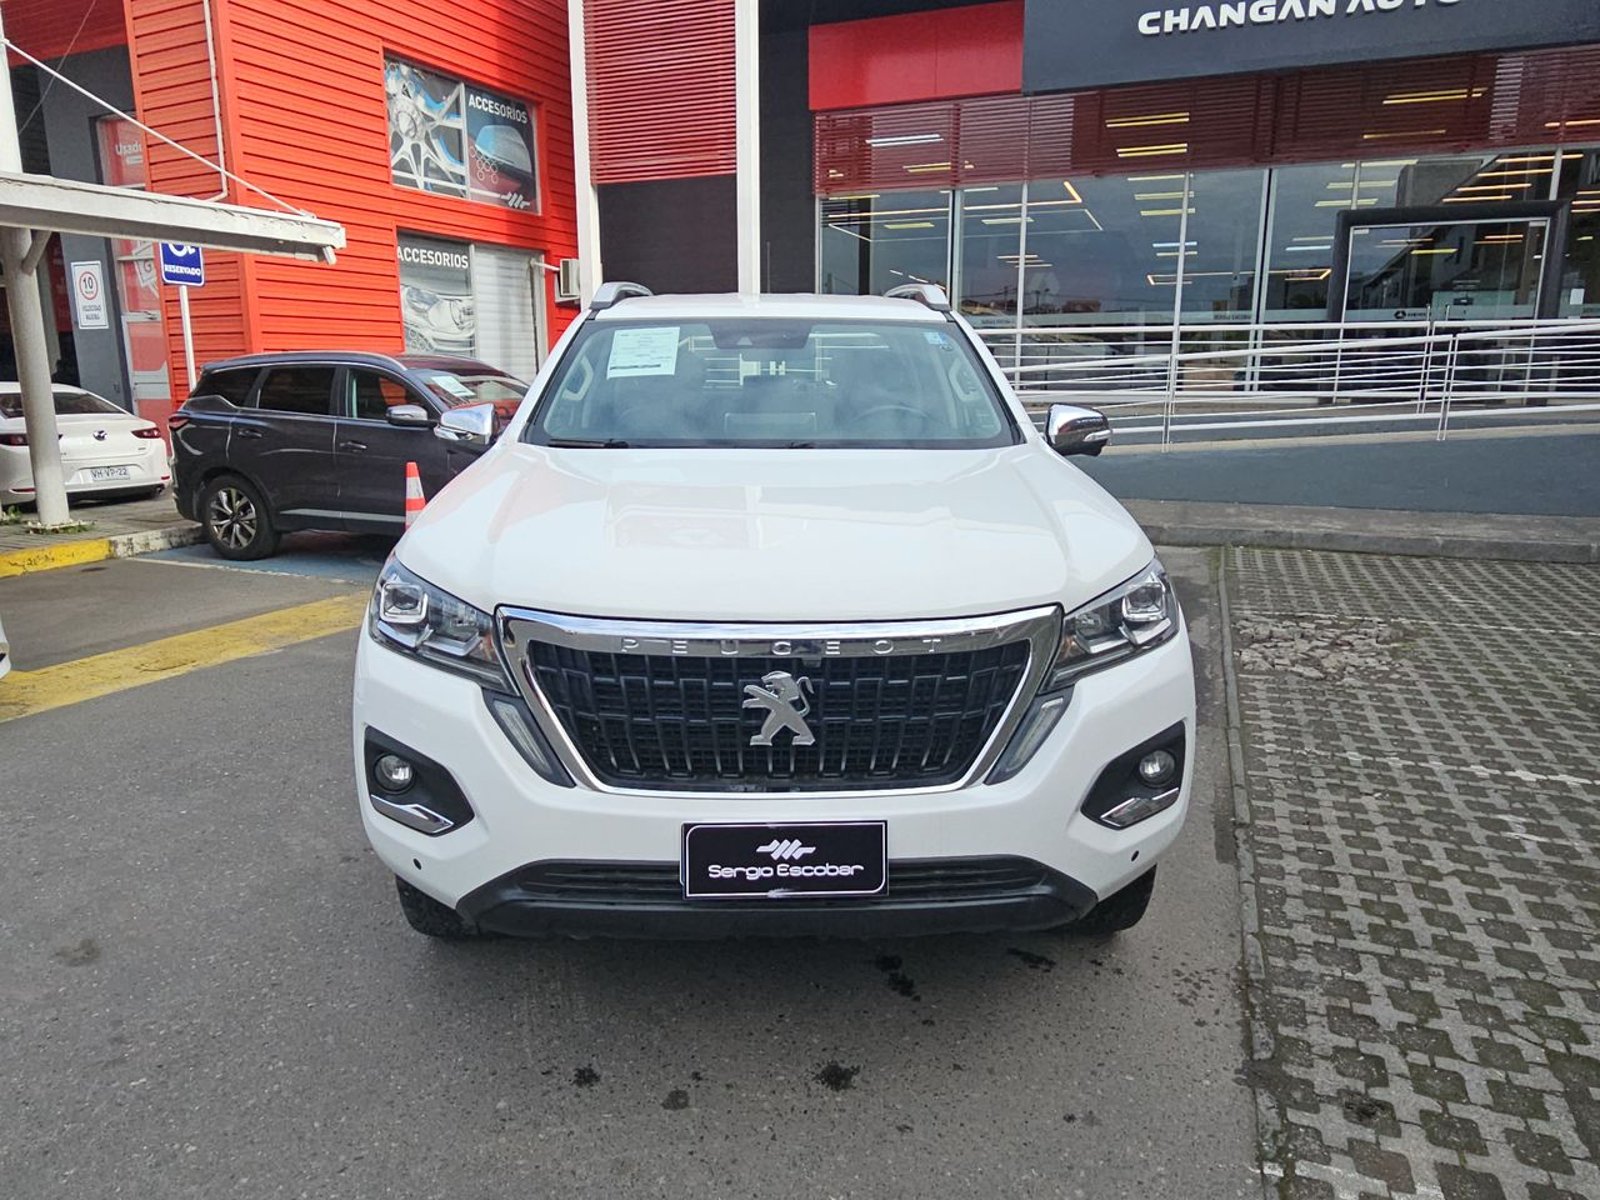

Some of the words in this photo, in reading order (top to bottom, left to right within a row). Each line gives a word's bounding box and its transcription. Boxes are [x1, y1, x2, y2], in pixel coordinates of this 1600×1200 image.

[1138, 0, 1335, 34] CHANGAN
[468, 94, 528, 124] ACCESORIOS
[83, 277, 94, 290] 10
[621, 637, 941, 655] PEUGEOT
[776, 862, 864, 877] Escobar
